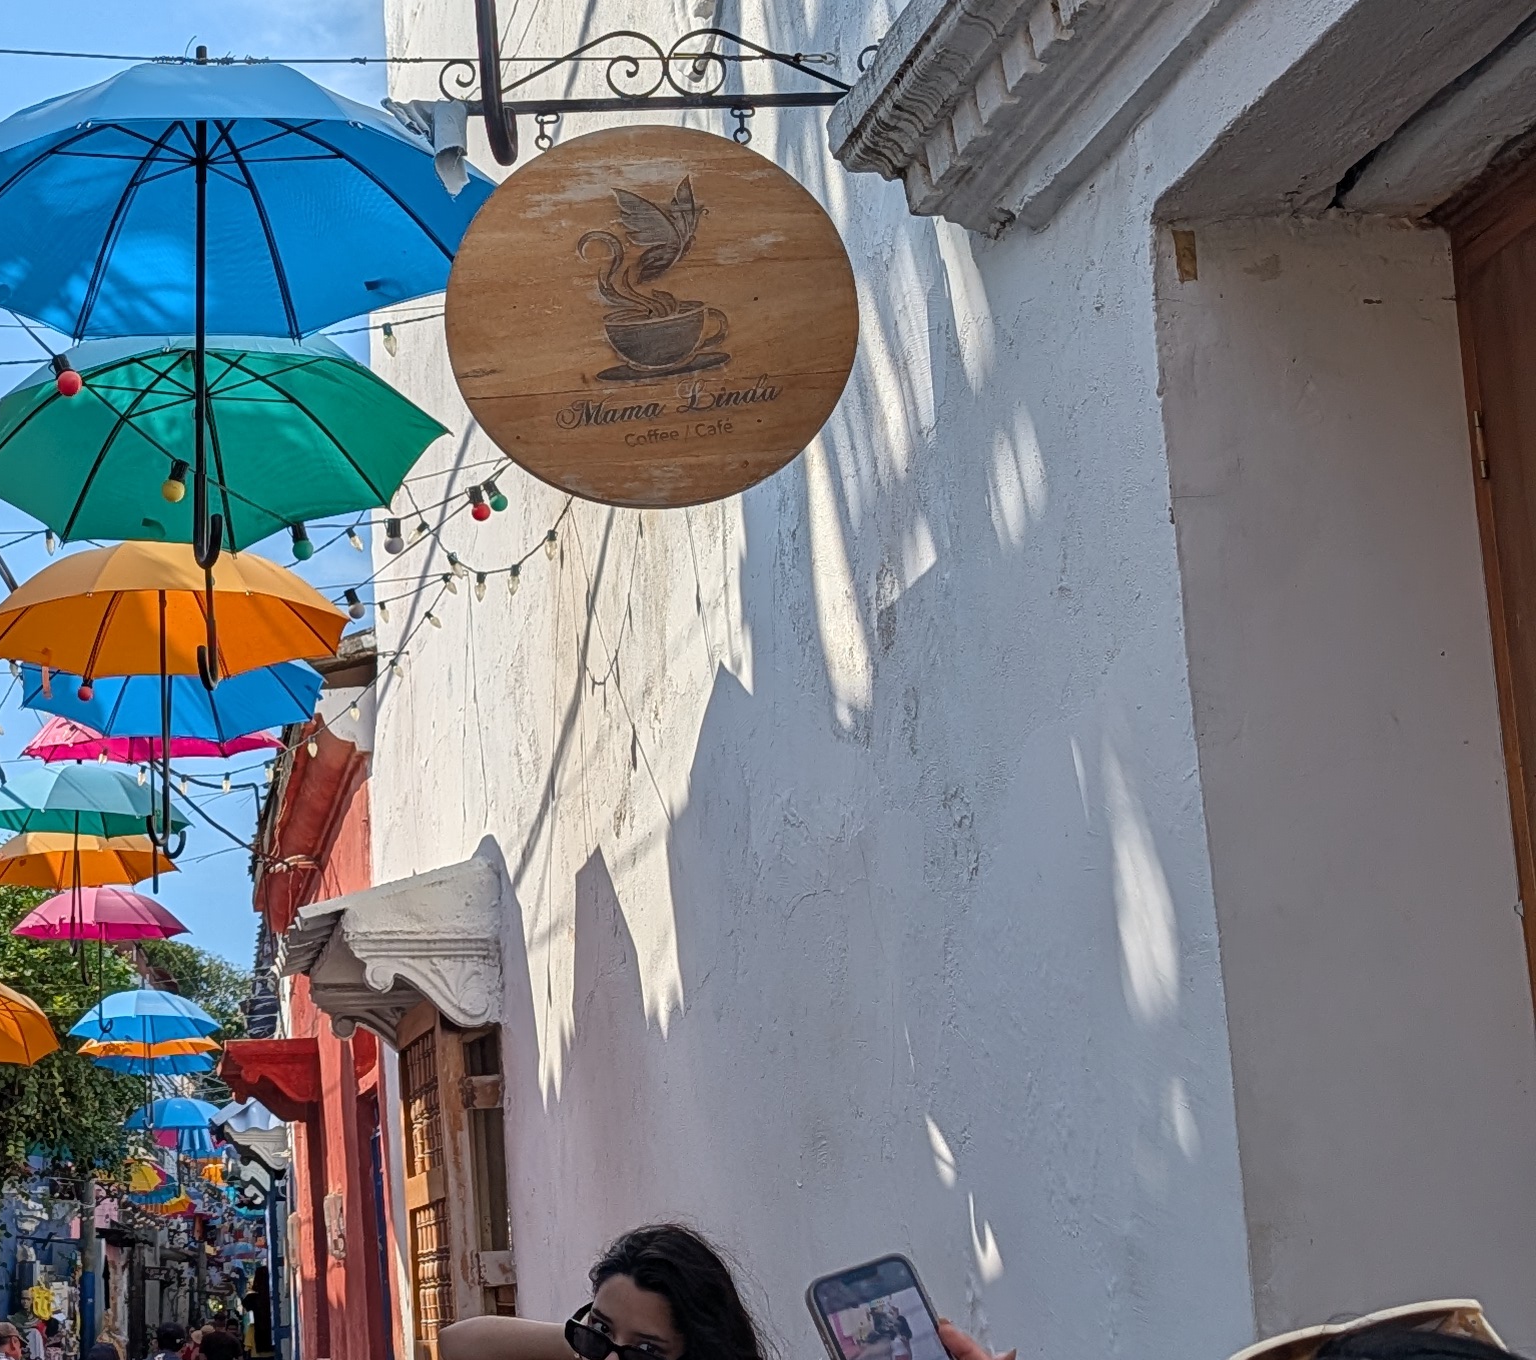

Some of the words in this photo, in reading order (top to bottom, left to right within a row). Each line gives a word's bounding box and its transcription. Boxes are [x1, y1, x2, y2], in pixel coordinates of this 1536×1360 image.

[556, 395, 666, 429] Mama
[676, 375, 783, 413] Linda
[624, 429, 680, 447] Coffee
[694, 418, 734, 437] Café
